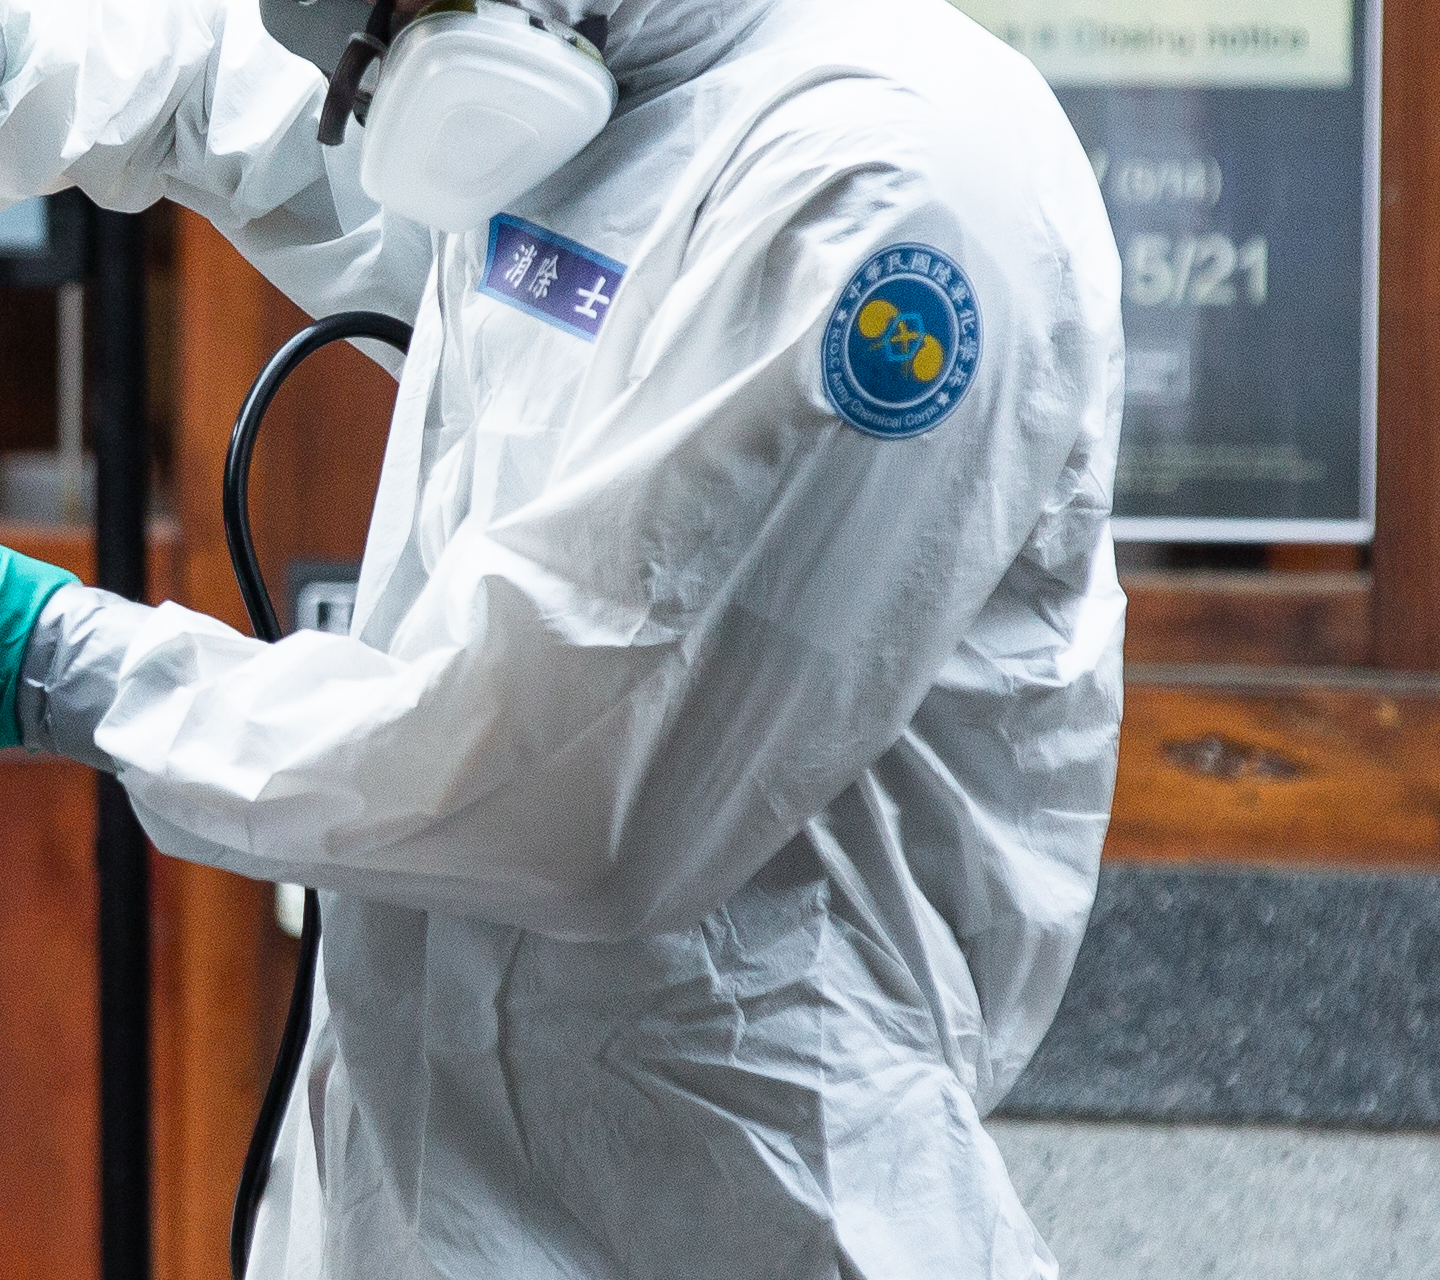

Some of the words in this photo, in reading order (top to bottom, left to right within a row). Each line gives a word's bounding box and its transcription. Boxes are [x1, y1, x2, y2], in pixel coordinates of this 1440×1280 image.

[1125, 233, 1269, 307] 5/21
[846, 251, 979, 388] 中華民國陸軍化學兵
[851, 400, 902, 429] Chemical
